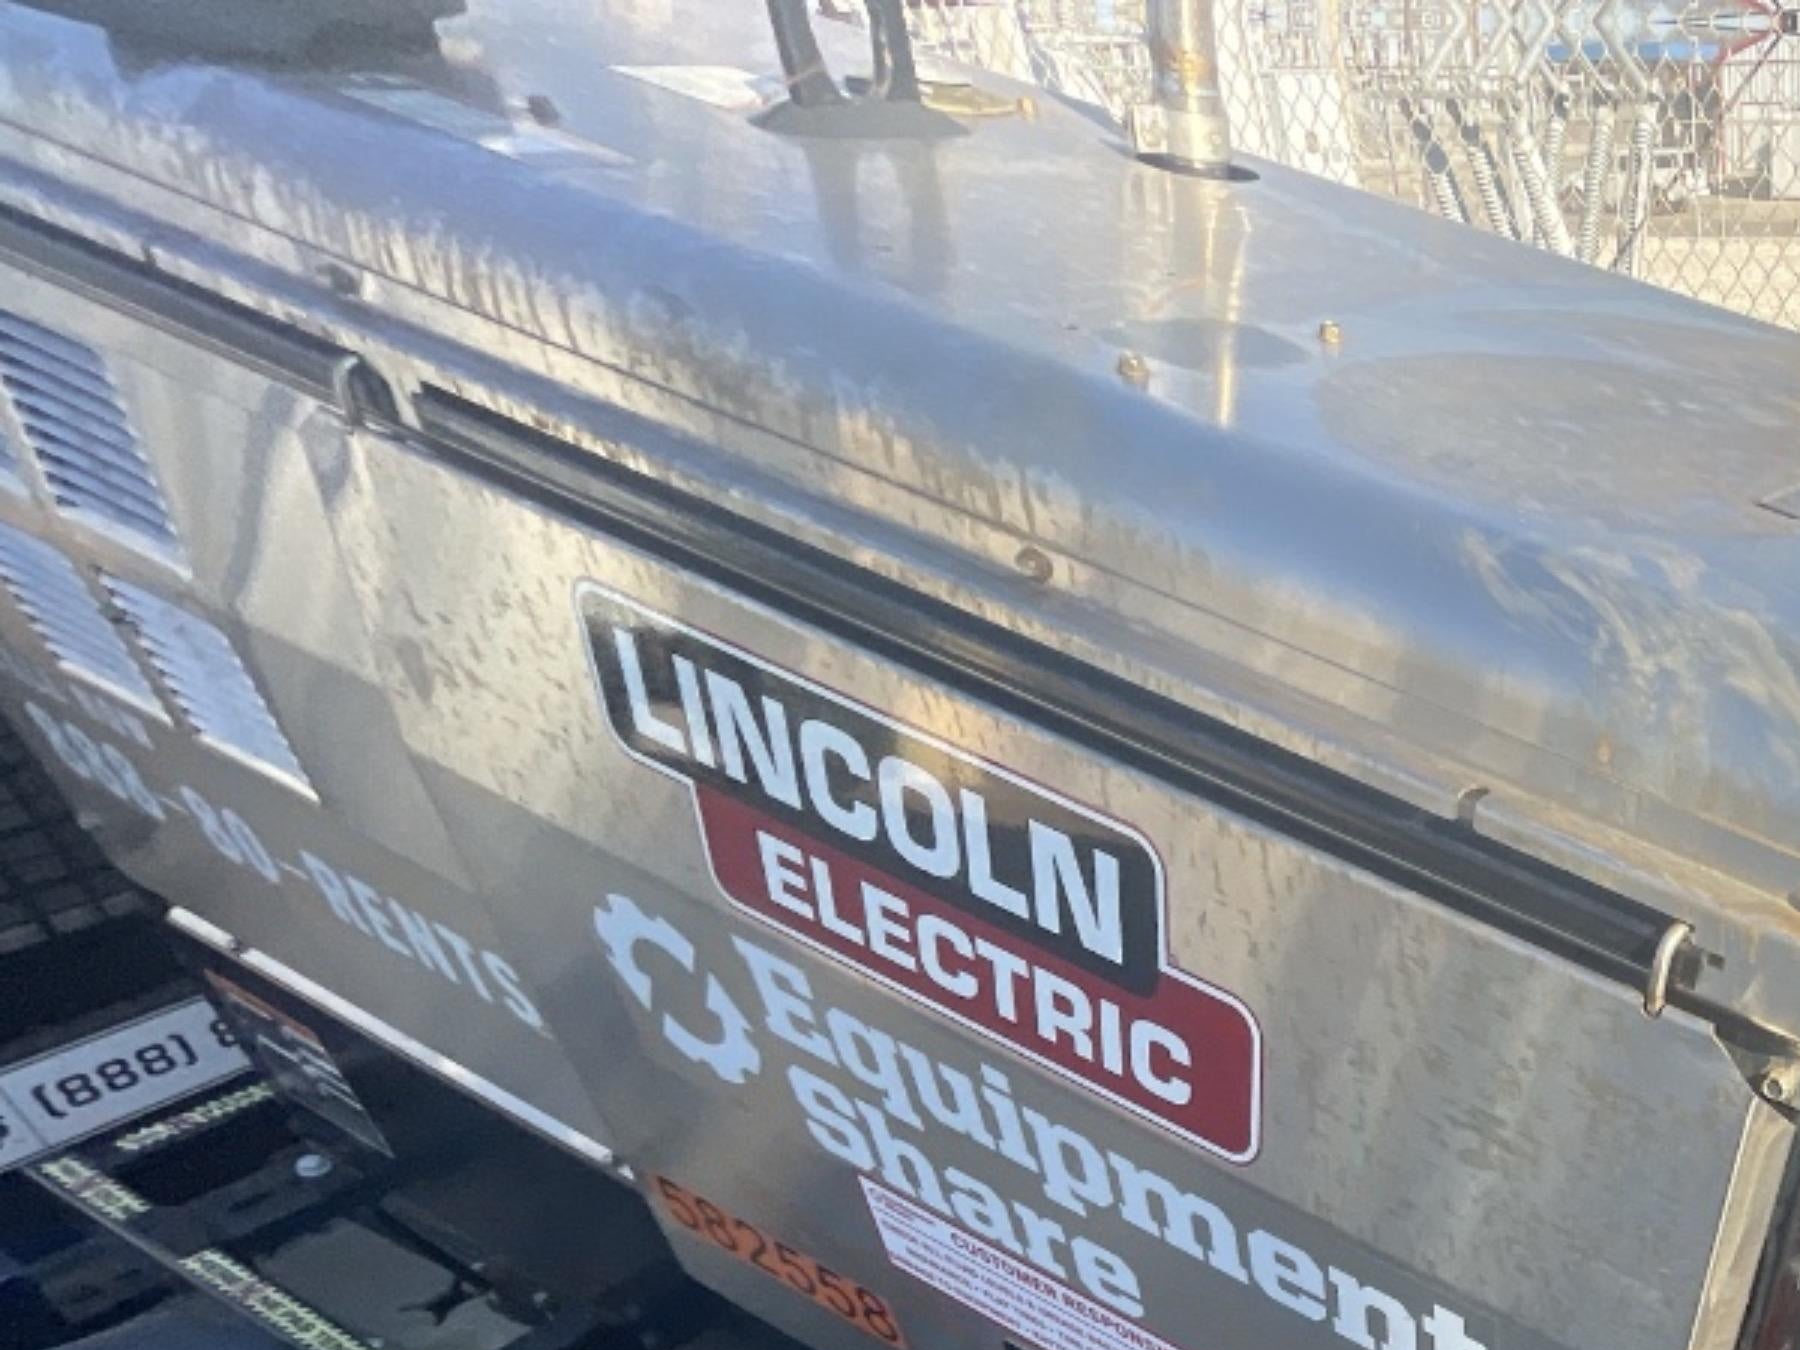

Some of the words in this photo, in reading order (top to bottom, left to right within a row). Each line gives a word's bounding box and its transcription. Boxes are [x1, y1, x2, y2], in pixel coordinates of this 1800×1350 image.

[613, 627, 1123, 965] LINCOLN
[756, 830, 1192, 1105] ELECTRIC
[31, 1033, 199, 1120] (888)
[657, 1176, 898, 1341] 582558
[787, 1064, 1145, 1318] Share
[950, 1232, 1057, 1299] CUSTOMER
